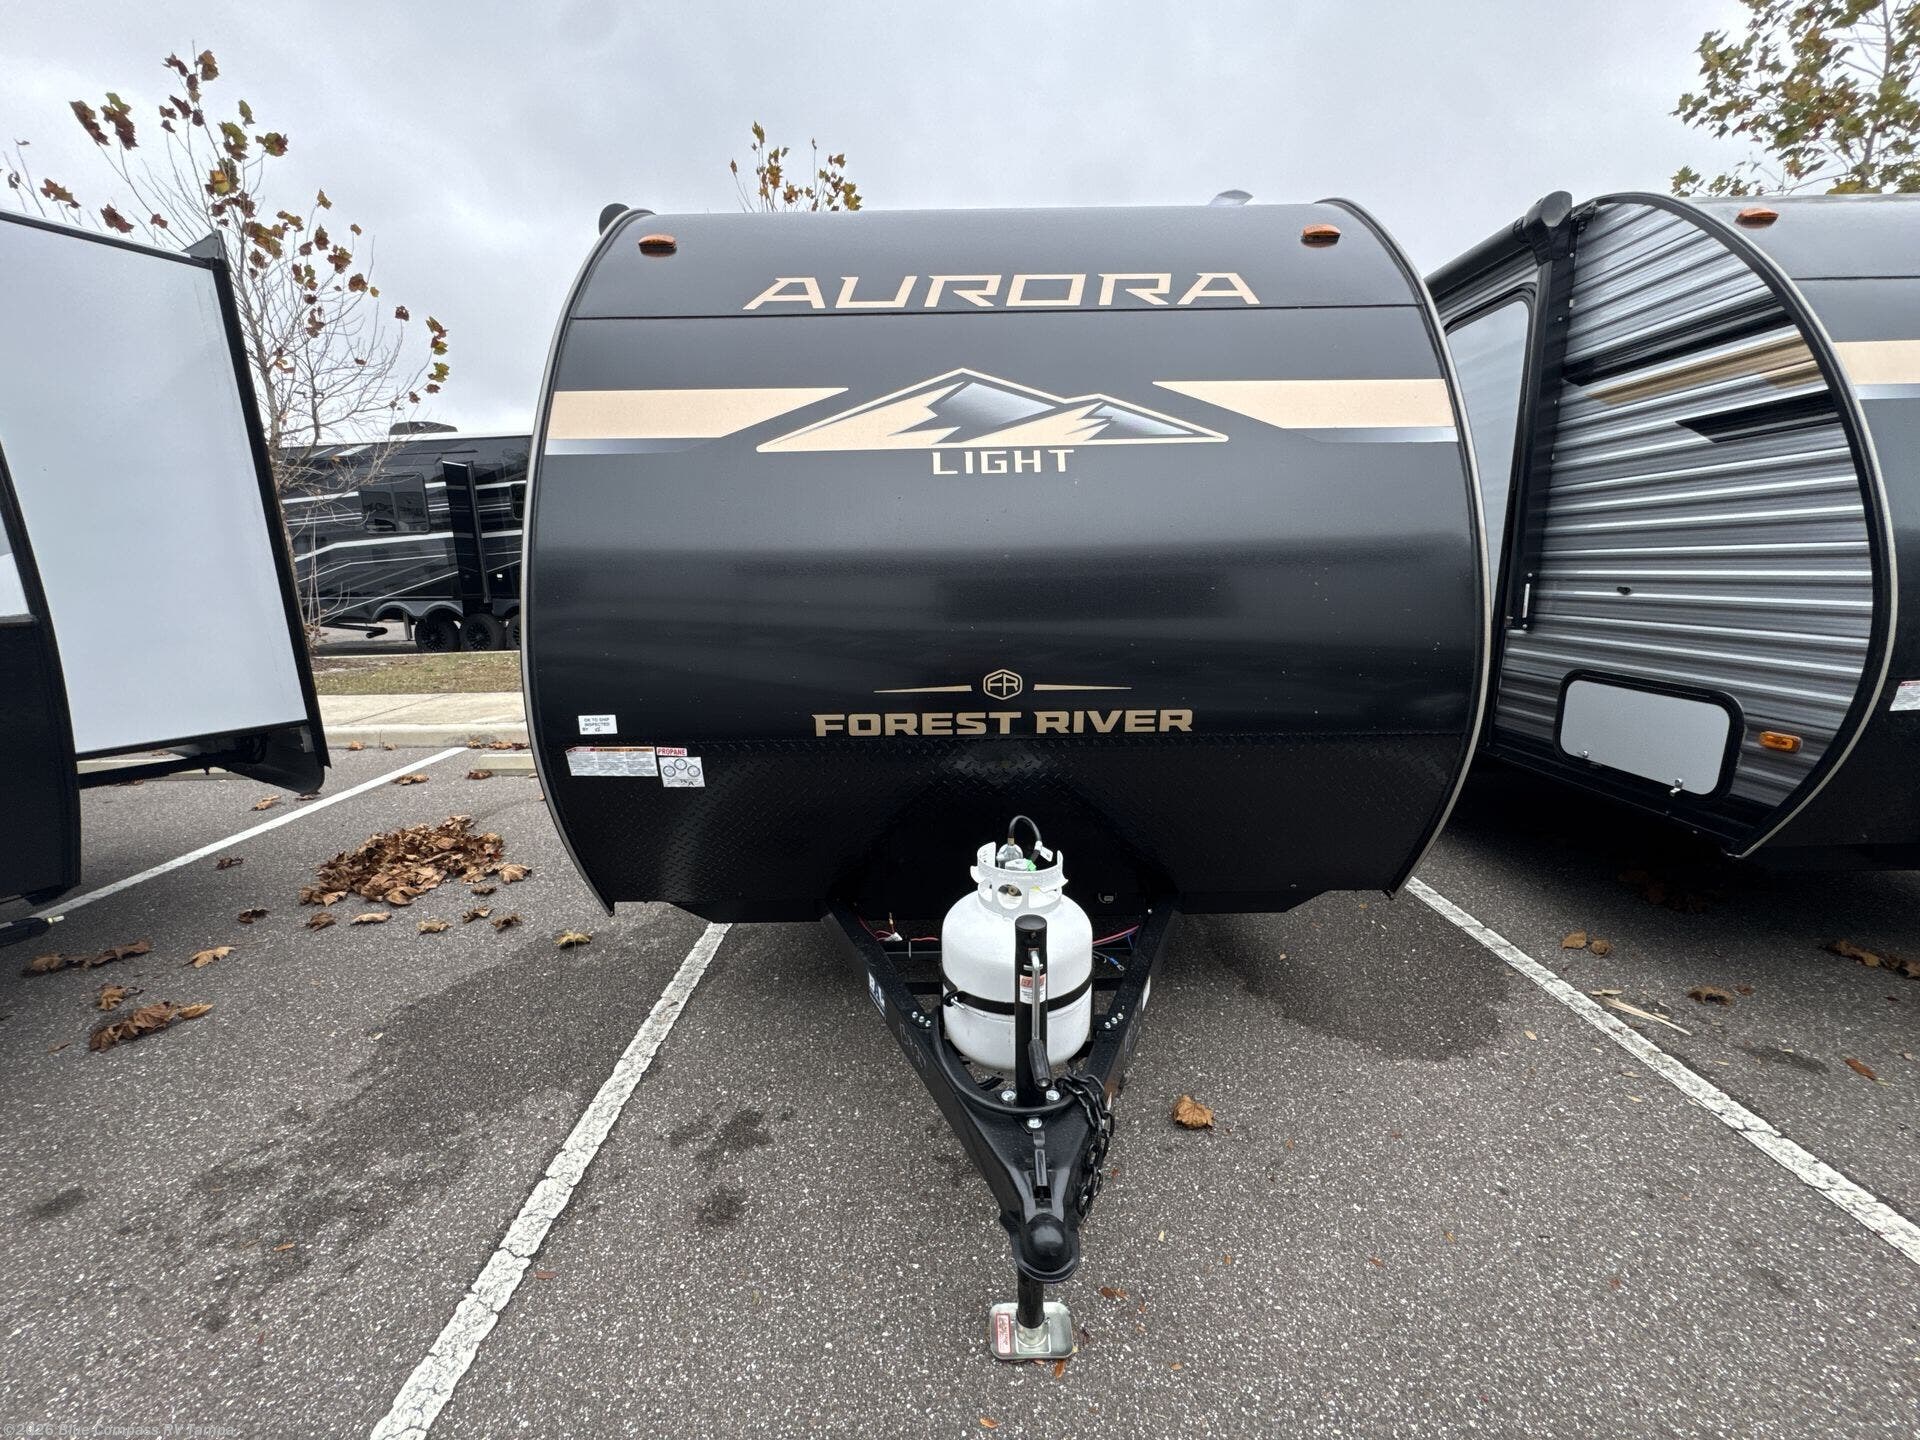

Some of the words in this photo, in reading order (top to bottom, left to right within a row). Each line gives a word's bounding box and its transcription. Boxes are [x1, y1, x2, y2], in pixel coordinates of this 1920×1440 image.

[742, 271, 1260, 310] AURORA
[932, 448, 1075, 475] LIGHT
[811, 711, 1022, 737] FOREST
[1033, 709, 1193, 735] RIVER
